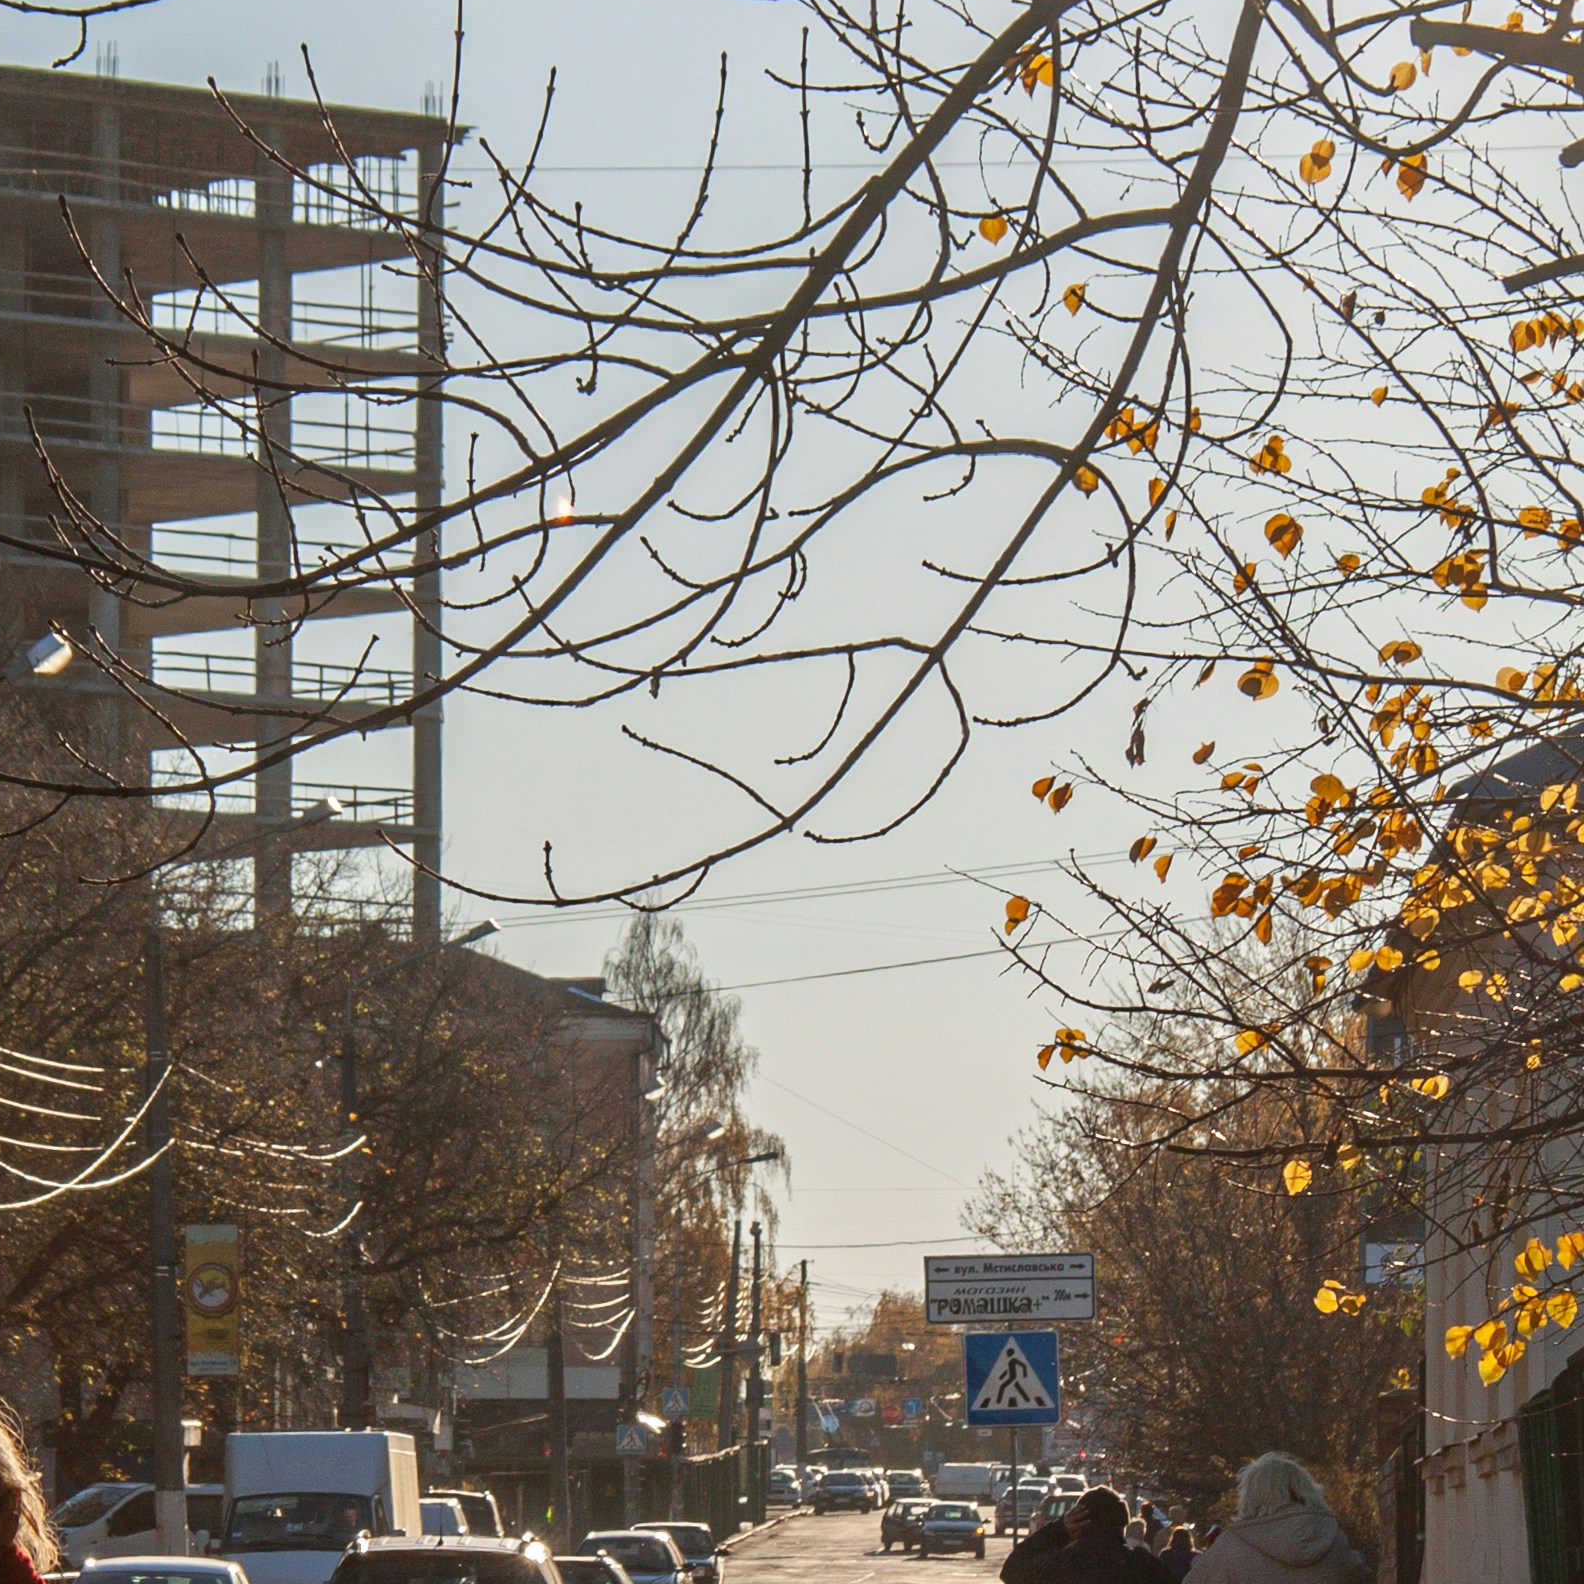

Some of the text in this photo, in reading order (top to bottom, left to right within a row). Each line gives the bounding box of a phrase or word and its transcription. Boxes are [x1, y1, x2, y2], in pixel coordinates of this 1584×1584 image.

[954, 1263, 1065, 1277] вул. Мстиславська
[953, 1286, 1026, 1296] магазин
